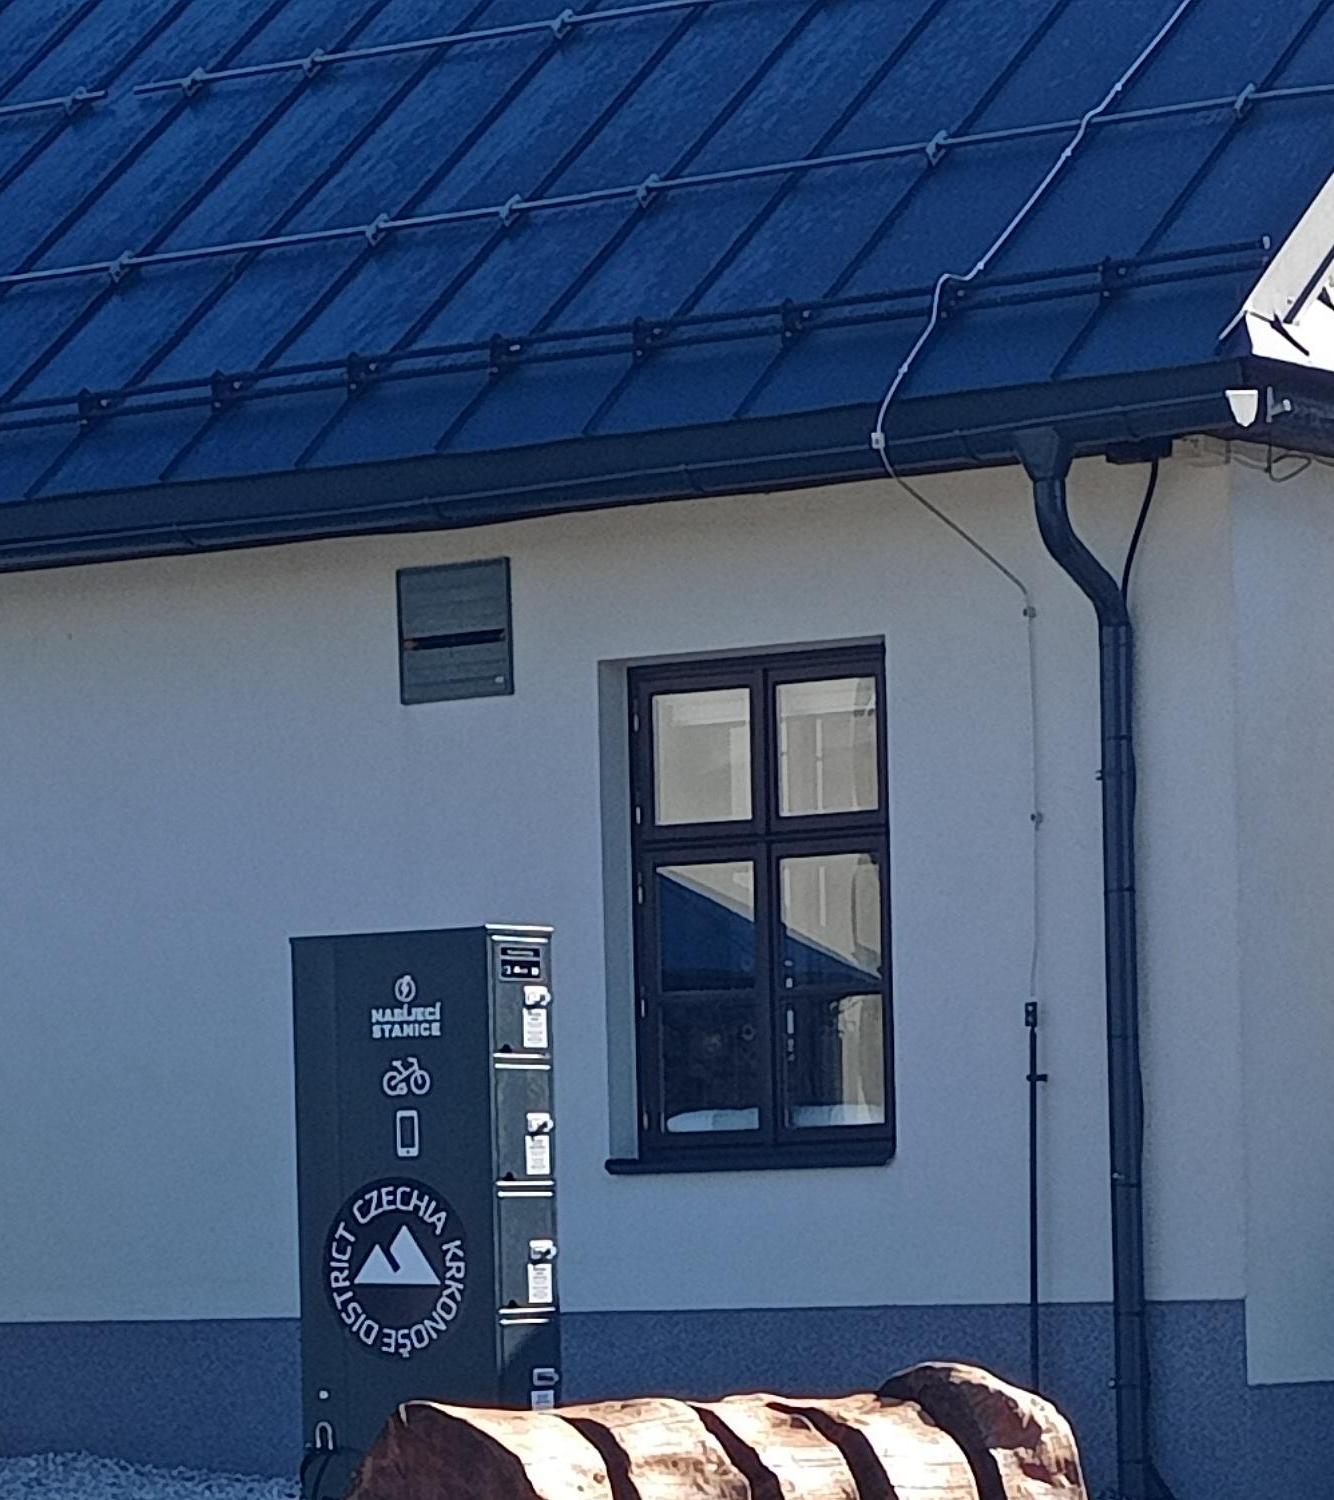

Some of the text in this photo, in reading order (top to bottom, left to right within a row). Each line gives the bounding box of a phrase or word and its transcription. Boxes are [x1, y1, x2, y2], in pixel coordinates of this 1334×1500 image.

[372, 1022, 441, 1038] STANICE
[330, 1186, 466, 1358] CZECHIA KRKONOŠE DISTRICT
